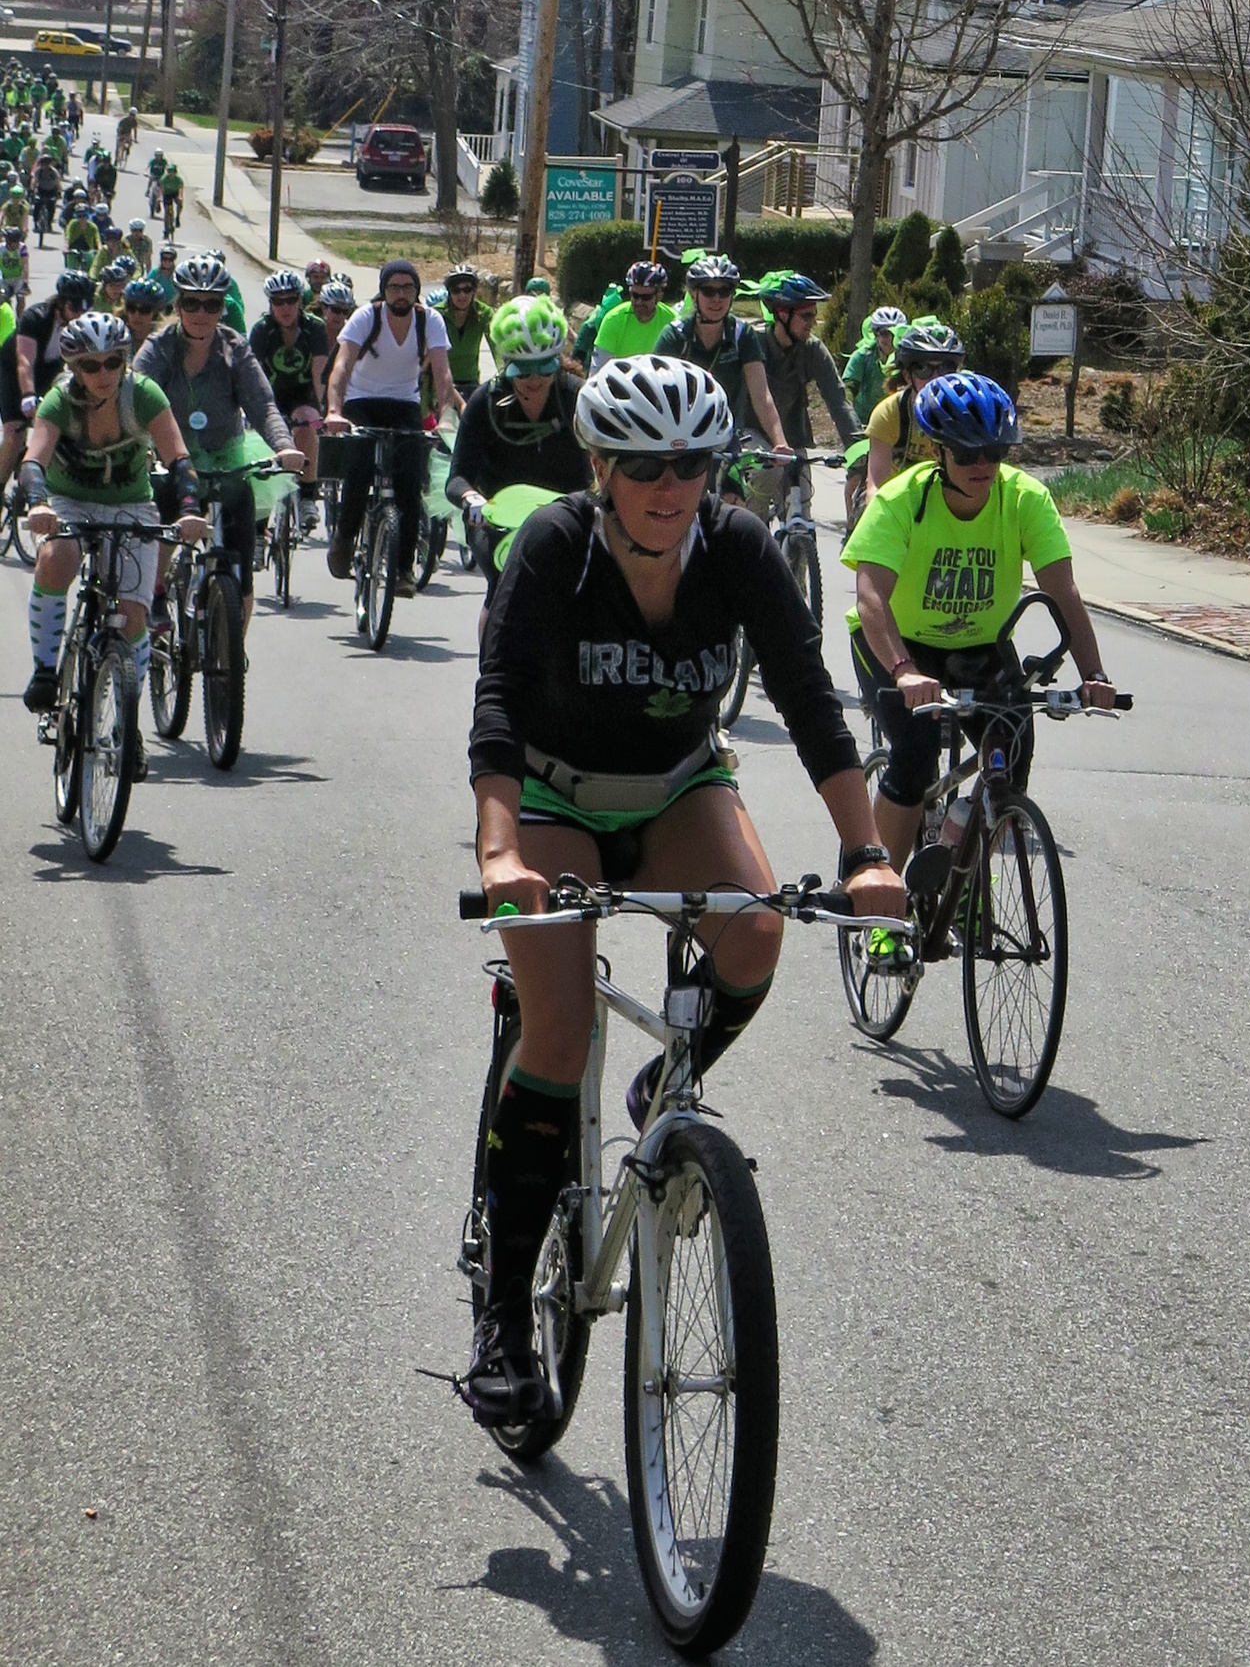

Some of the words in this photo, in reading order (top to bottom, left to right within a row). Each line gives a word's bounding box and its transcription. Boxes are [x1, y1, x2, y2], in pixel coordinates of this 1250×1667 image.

[547, 190, 614, 202] AVAILABLE
[932, 548, 963, 567] ARE
[966, 547, 997, 568] YOU
[924, 567, 995, 601] MAD
[922, 598, 994, 615] ENOUGH?
[578, 639, 737, 692] IRELAN
